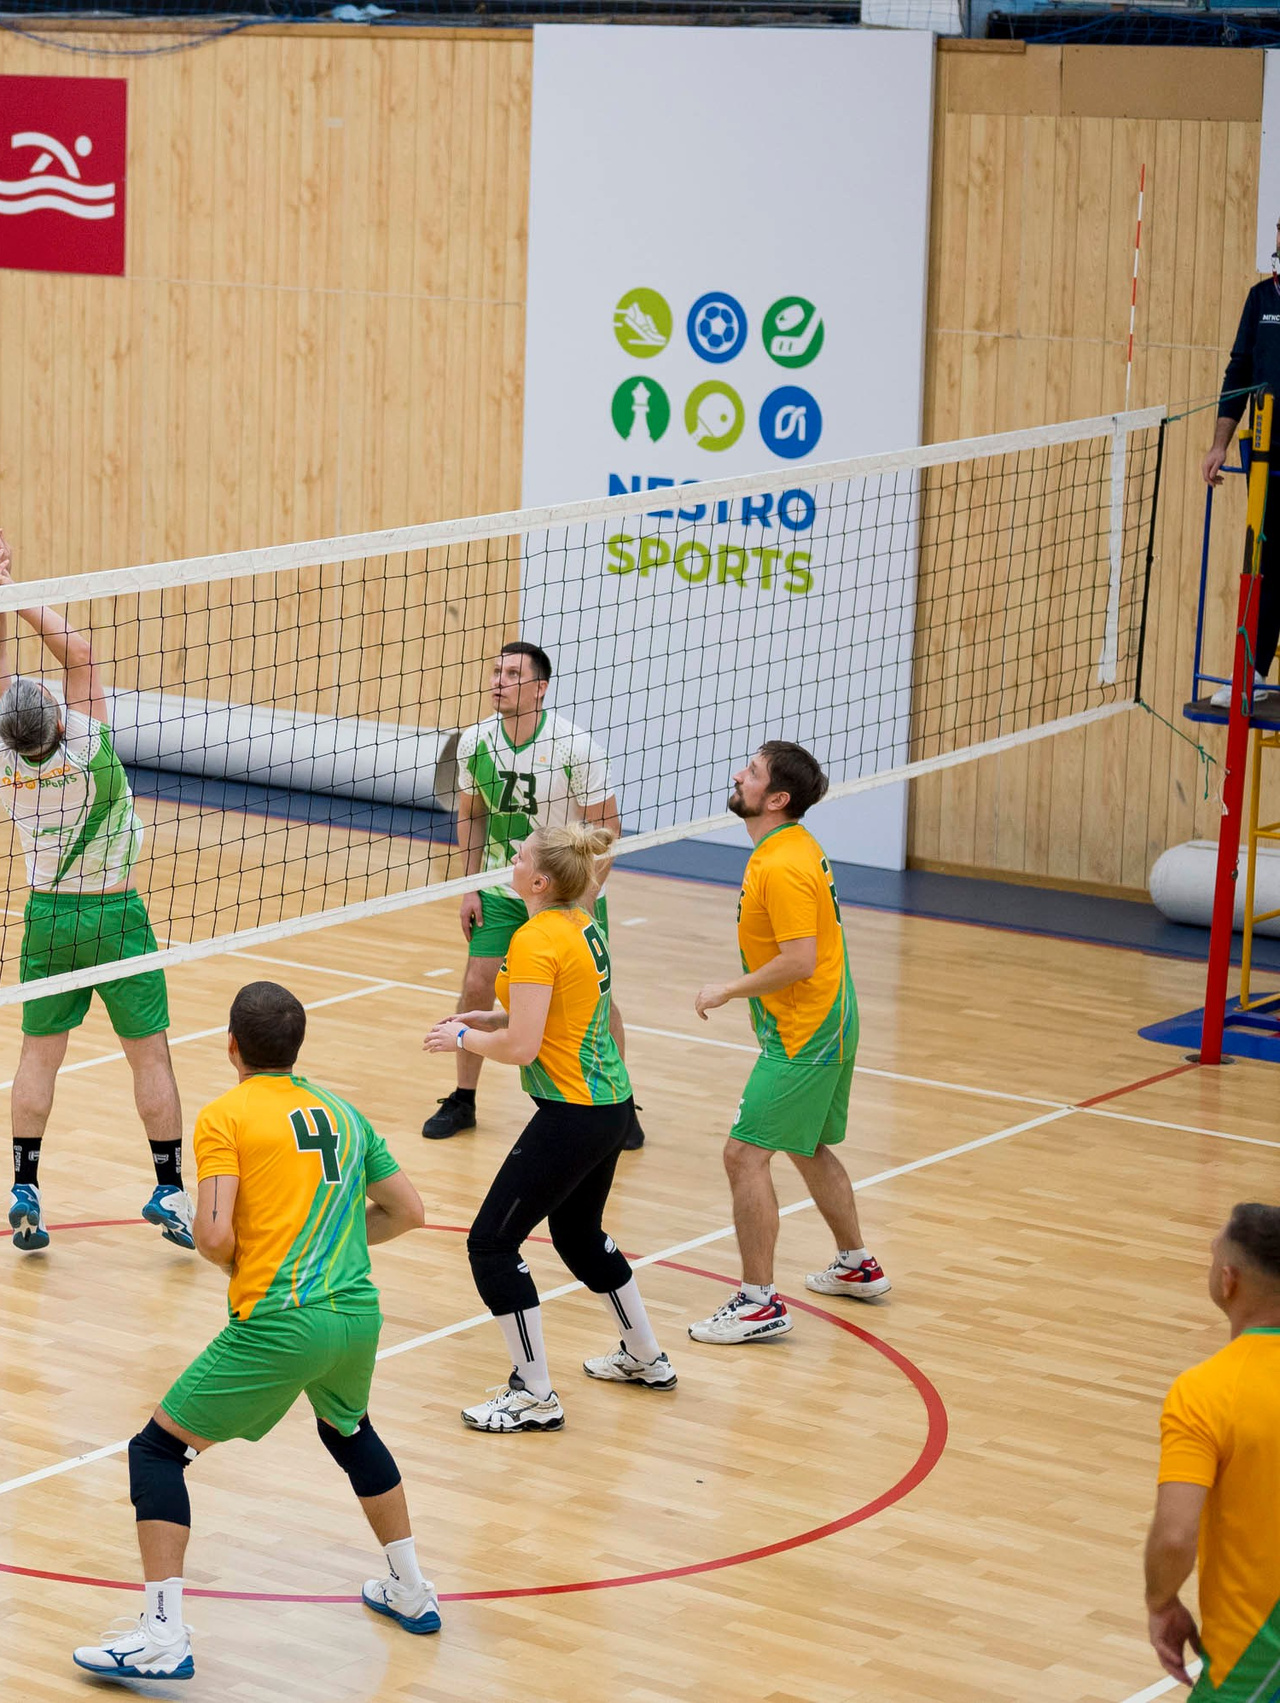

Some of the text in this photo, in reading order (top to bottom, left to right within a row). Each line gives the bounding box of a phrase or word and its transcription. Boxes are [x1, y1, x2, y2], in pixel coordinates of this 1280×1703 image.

[606, 533, 815, 595] SPORTS
[498, 770, 538, 815] 23
[582, 922, 612, 997] 9
[287, 1106, 343, 1185] 4
